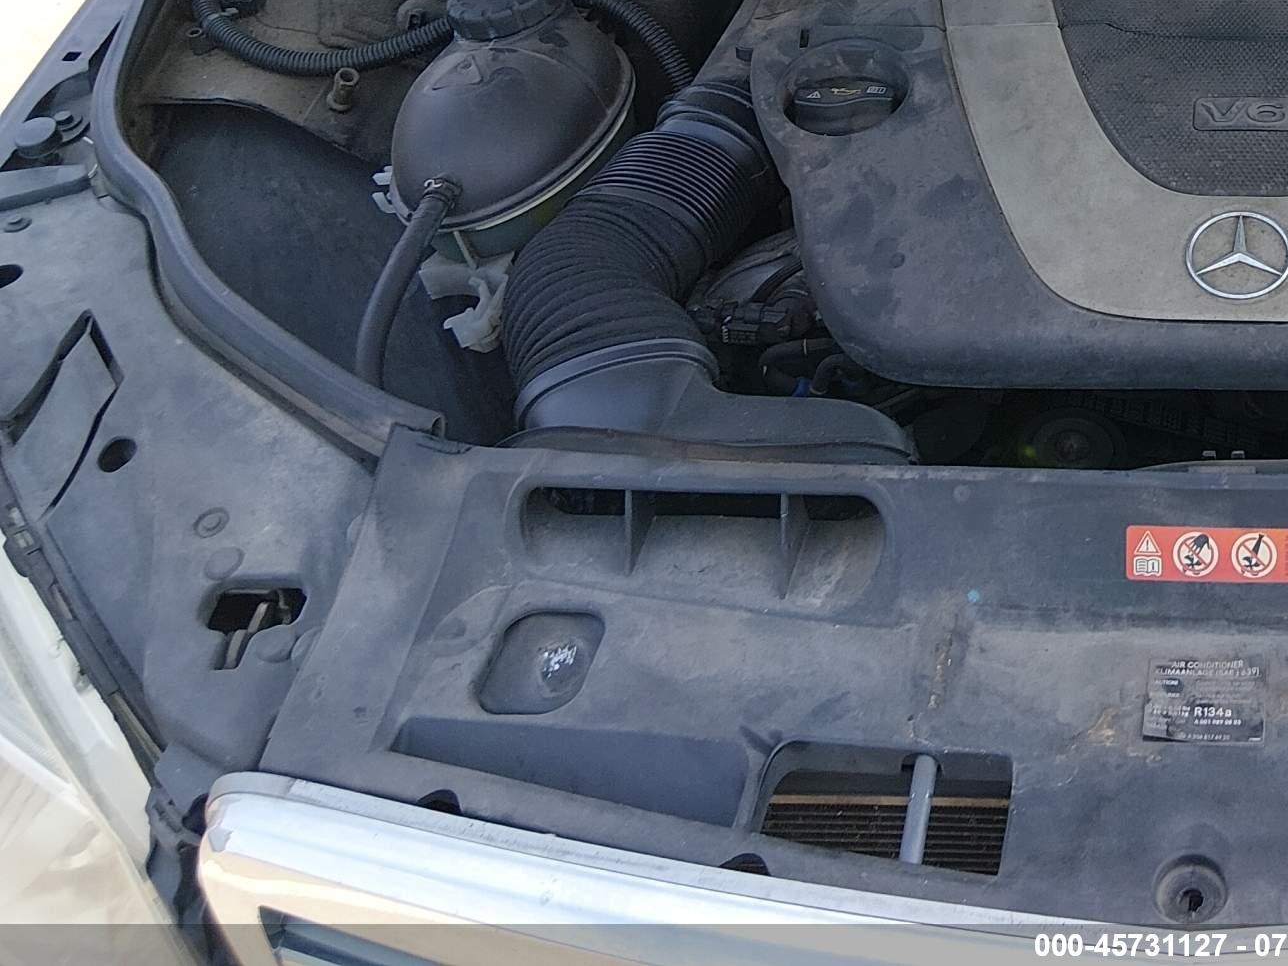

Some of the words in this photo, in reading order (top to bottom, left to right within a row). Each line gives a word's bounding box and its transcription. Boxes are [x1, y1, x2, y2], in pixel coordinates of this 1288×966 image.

[1201, 101, 1285, 123] V6
[1171, 660, 1186, 668] AIR
[1193, 706, 1232, 717] R134a
